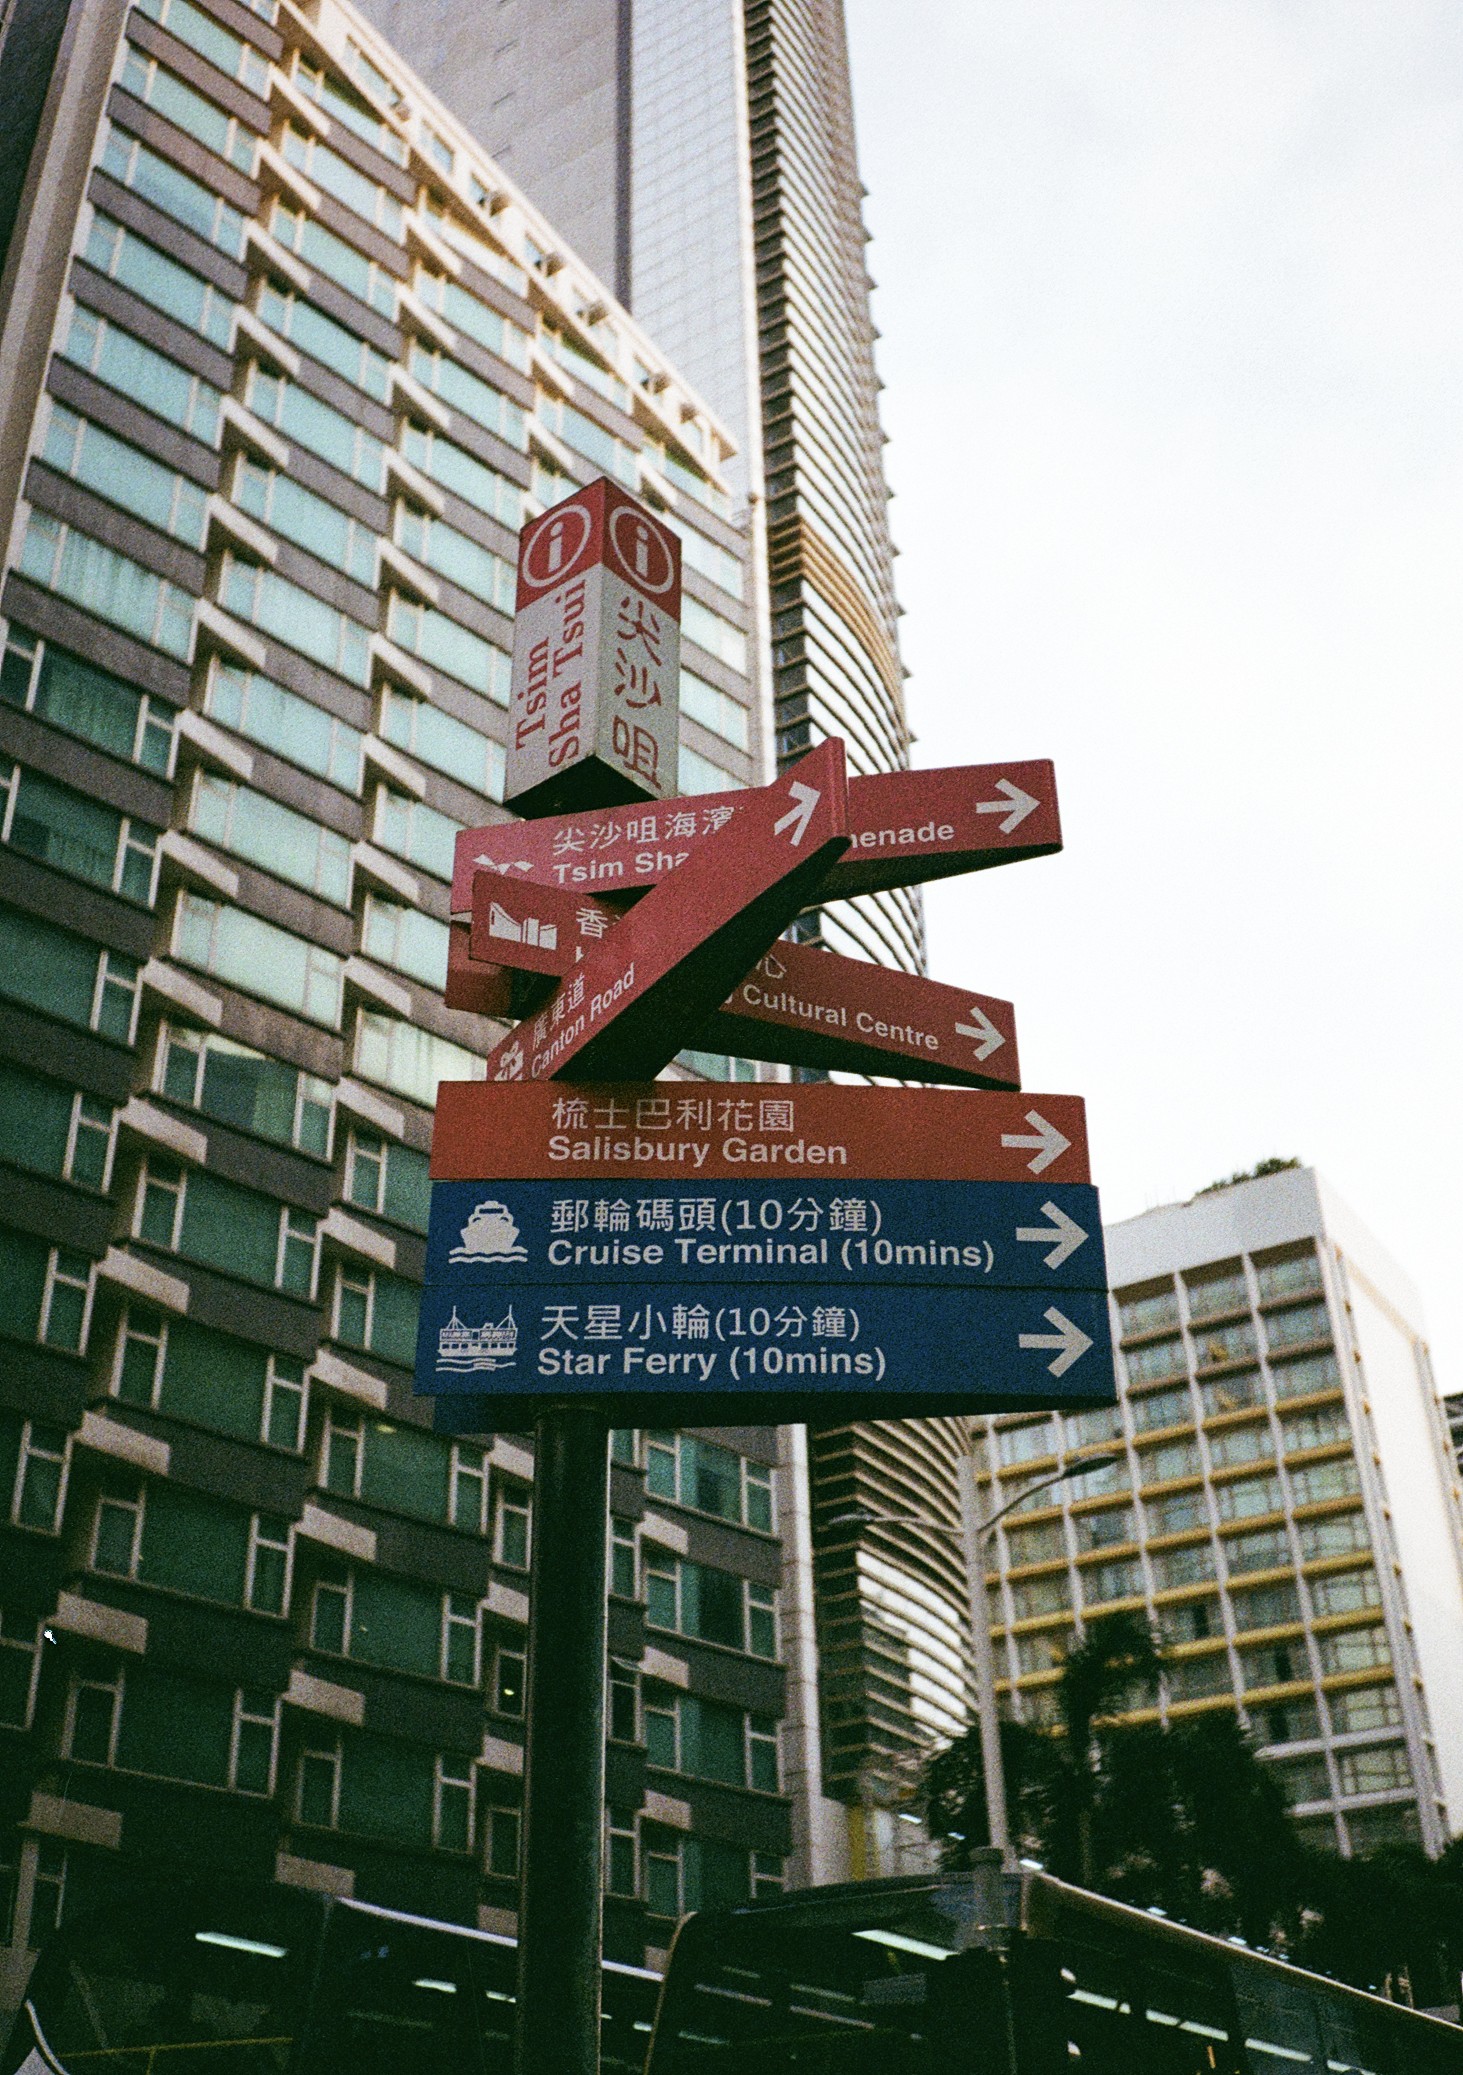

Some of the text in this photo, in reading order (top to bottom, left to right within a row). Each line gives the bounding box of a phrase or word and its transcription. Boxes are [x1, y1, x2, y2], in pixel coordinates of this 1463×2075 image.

[515, 637, 549, 750] Tsim
[549, 579, 586, 767] Sha Tsui
[612, 596, 662, 790] 尖沙咀
[553, 859, 624, 884] Tsim
[850, 821, 955, 849] enade
[531, 961, 635, 1079] Canton Road
[532, 972, 585, 1051] 廣東道
[743, 983, 939, 1051] Cultural Centre
[551, 1097, 795, 1132] 梳士巴利花園
[548, 1135, 847, 1167] Salisbury Garden
[551, 1197, 882, 1236] 郵輪碼頭(10分鐘)
[548, 1238, 994, 1273] Cruise Terminal (10mins)
[540, 1304, 860, 1342] 天星小輪(10分鐘)
[537, 1347, 886, 1382] Star Ferry (10mins)
